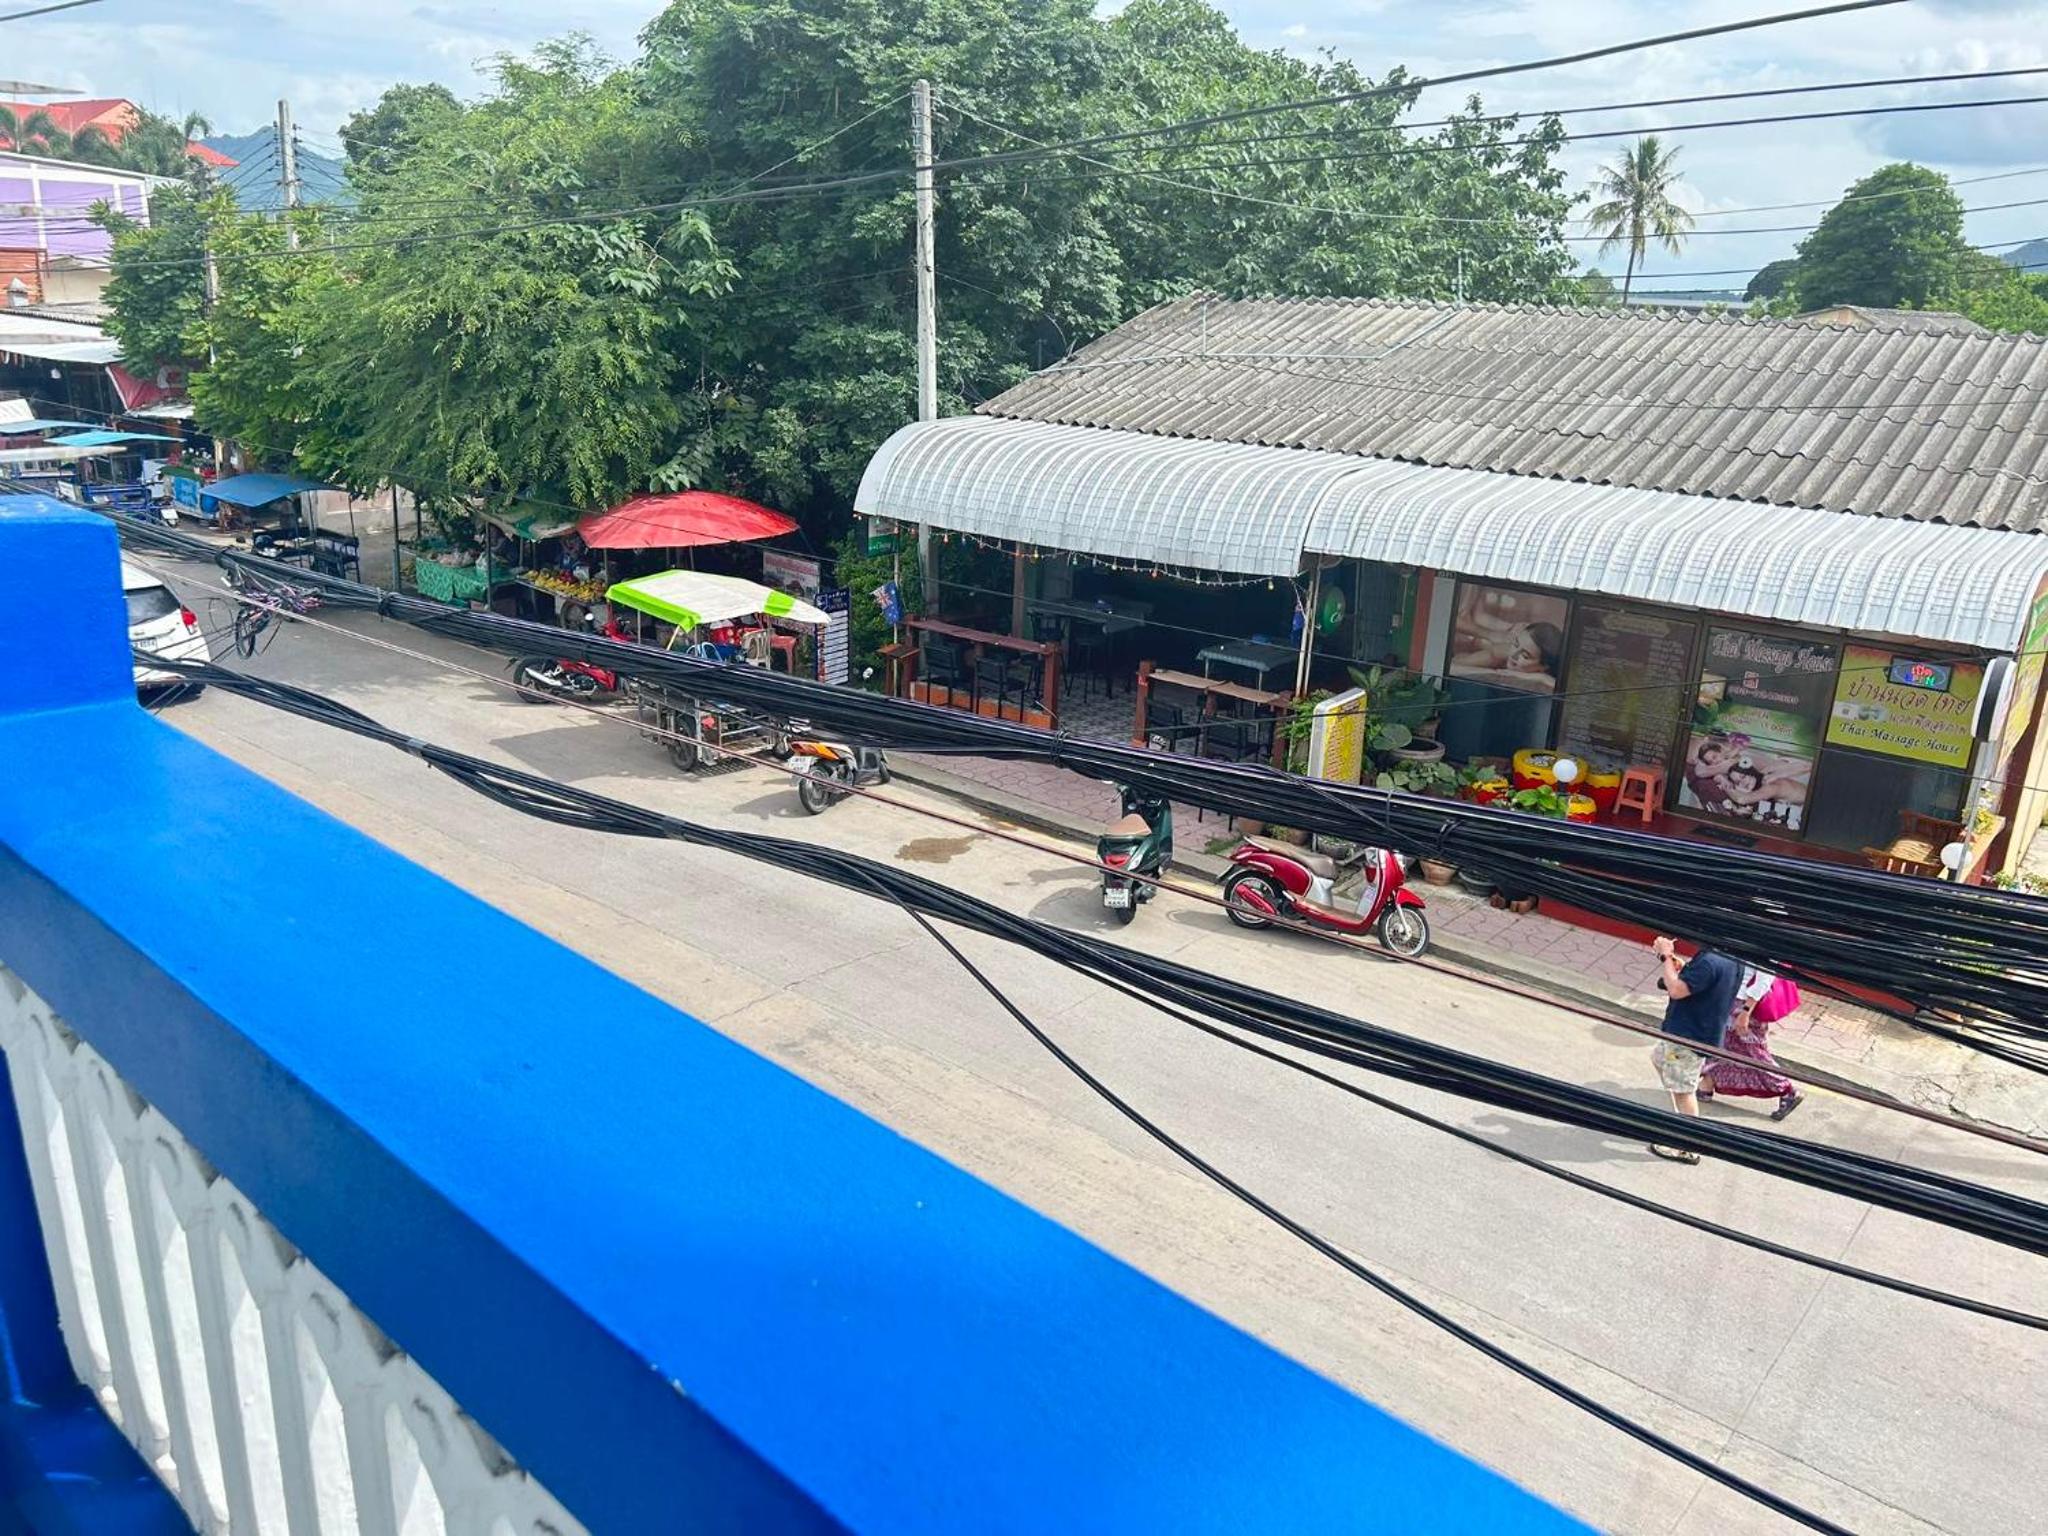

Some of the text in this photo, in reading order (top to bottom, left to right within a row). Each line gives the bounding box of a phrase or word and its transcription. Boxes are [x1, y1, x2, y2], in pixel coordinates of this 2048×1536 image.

[1840, 721, 1961, 755] Thai Massage House
